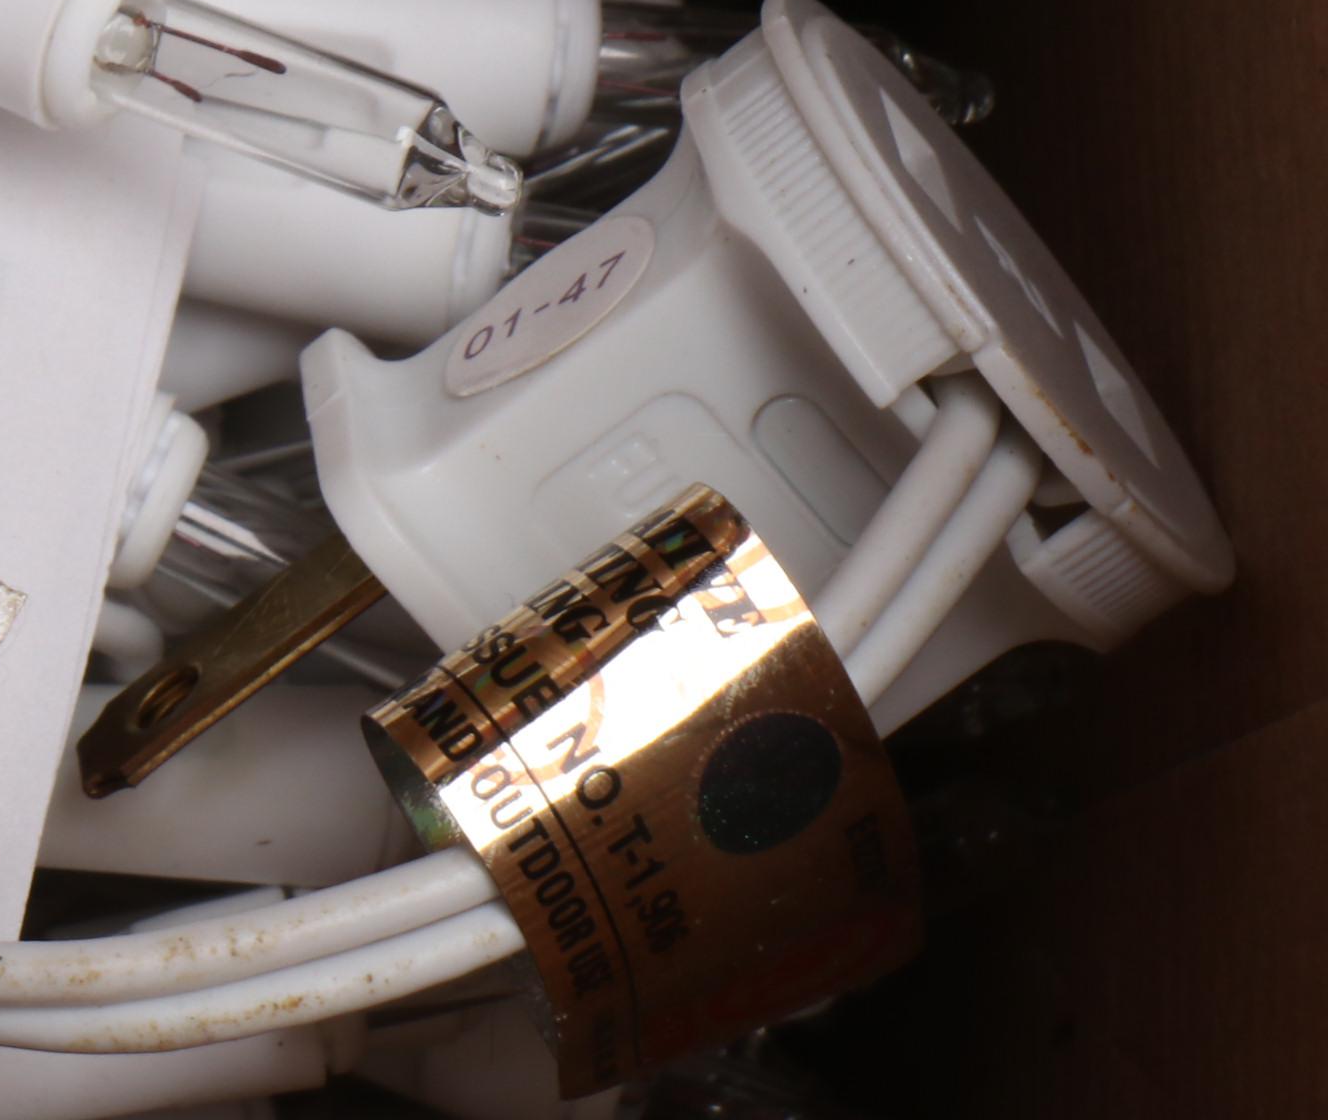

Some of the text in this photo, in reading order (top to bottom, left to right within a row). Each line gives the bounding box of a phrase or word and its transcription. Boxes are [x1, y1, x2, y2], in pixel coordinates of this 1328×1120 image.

[462, 249, 628, 361] 01-47
[402, 692, 482, 765] AND
[470, 765, 598, 953] OUTDOOR
[545, 723, 623, 828] NO.
